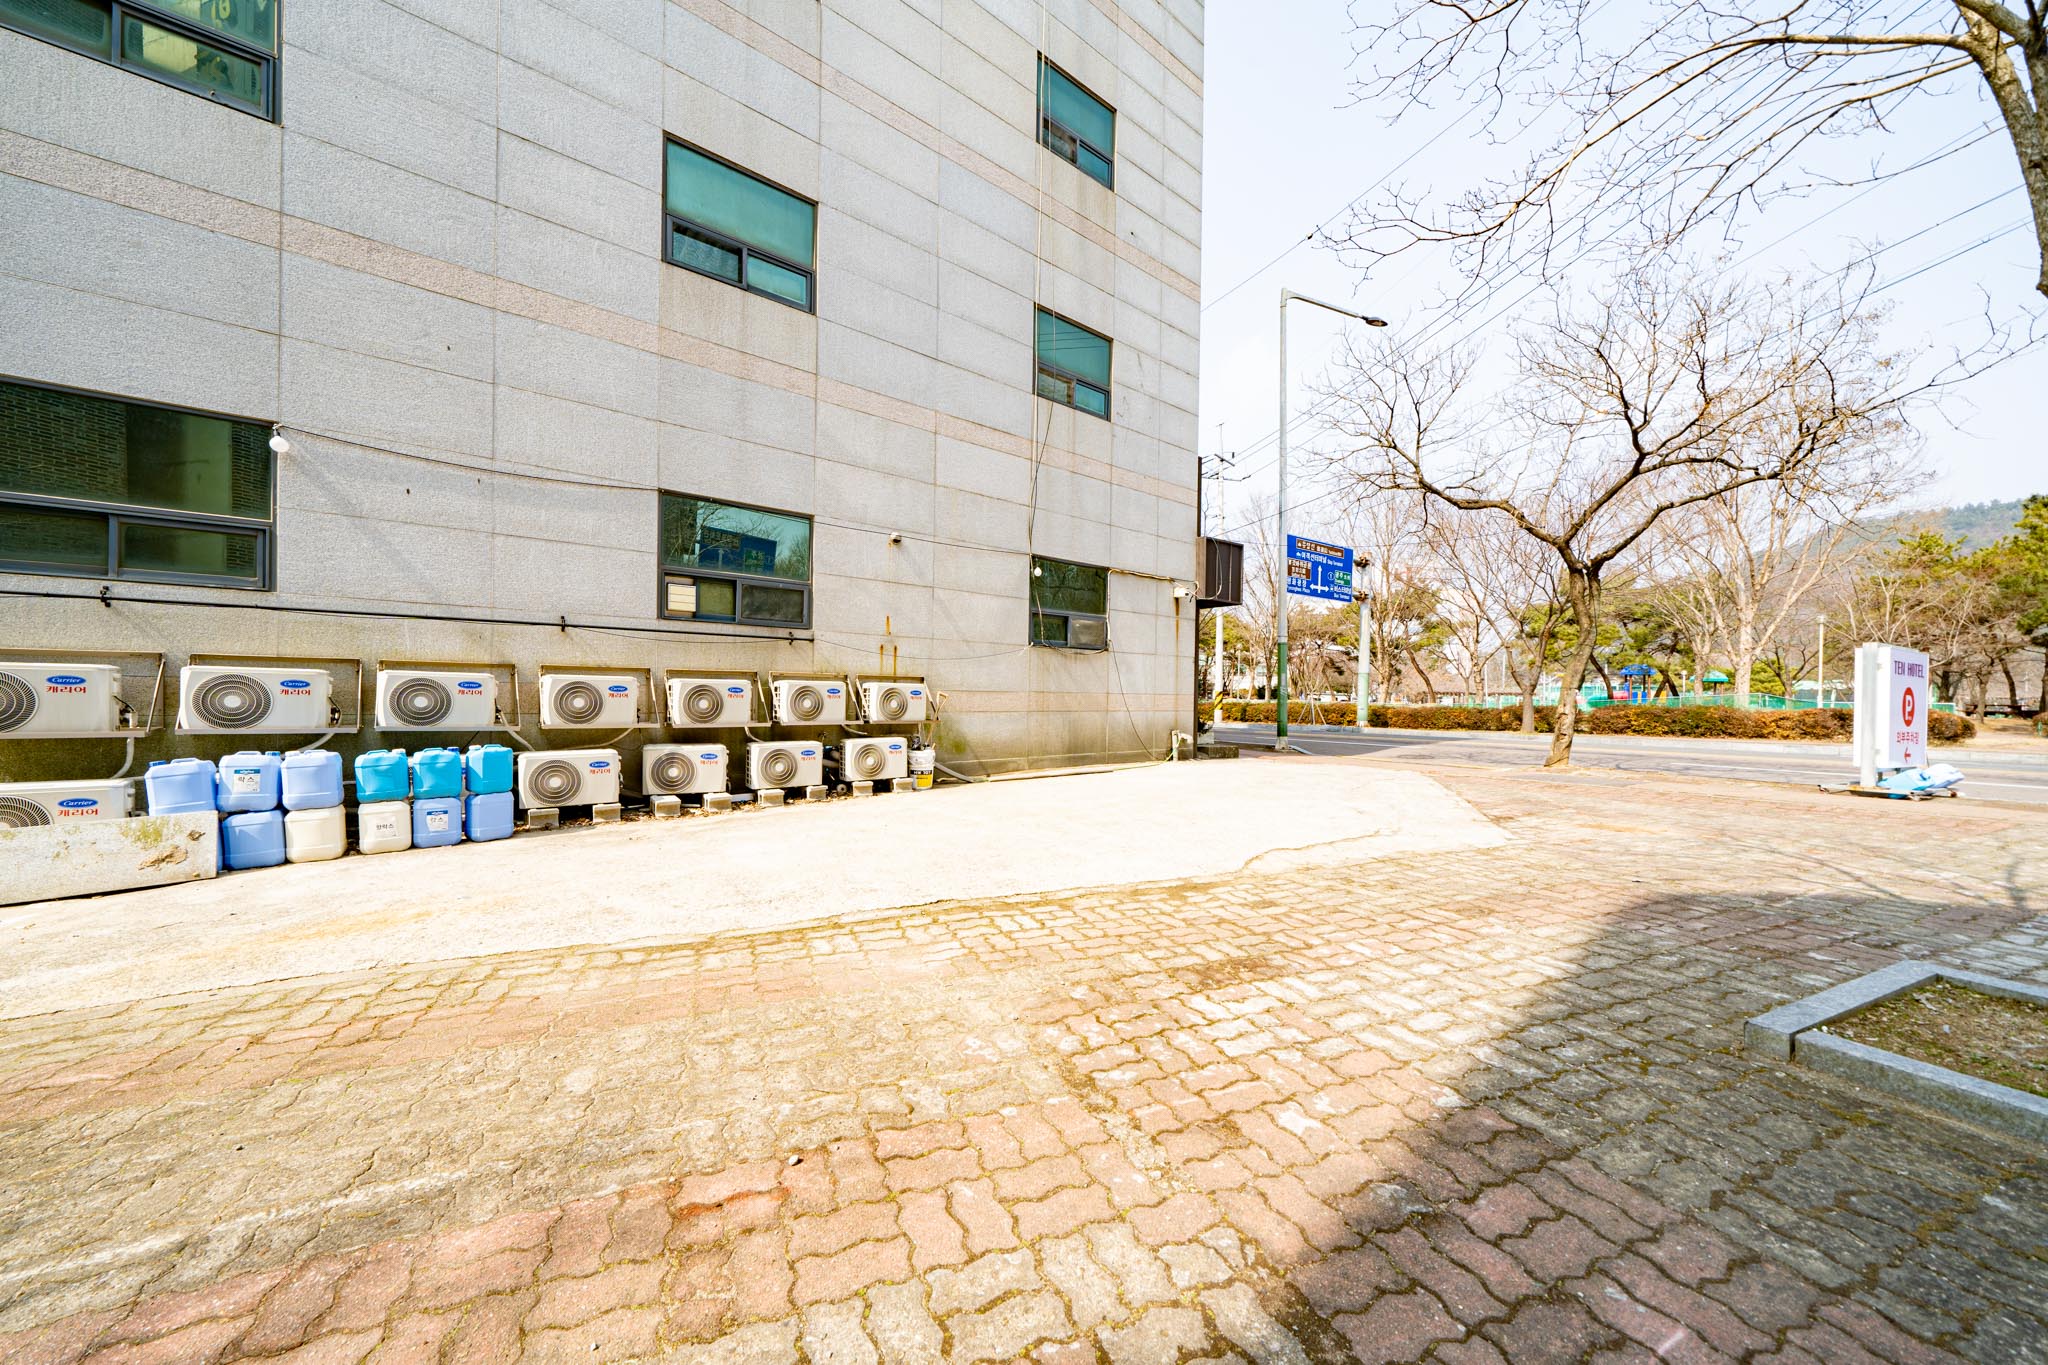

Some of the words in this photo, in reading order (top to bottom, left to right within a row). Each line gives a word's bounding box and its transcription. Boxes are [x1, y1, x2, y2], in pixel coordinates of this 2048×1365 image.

[1894, 660, 1906, 676] TEN
[1907, 662, 1924, 679] HOTEL
[46, 685, 86, 694] 캐리어
[57, 808, 98, 816] 캐리어
